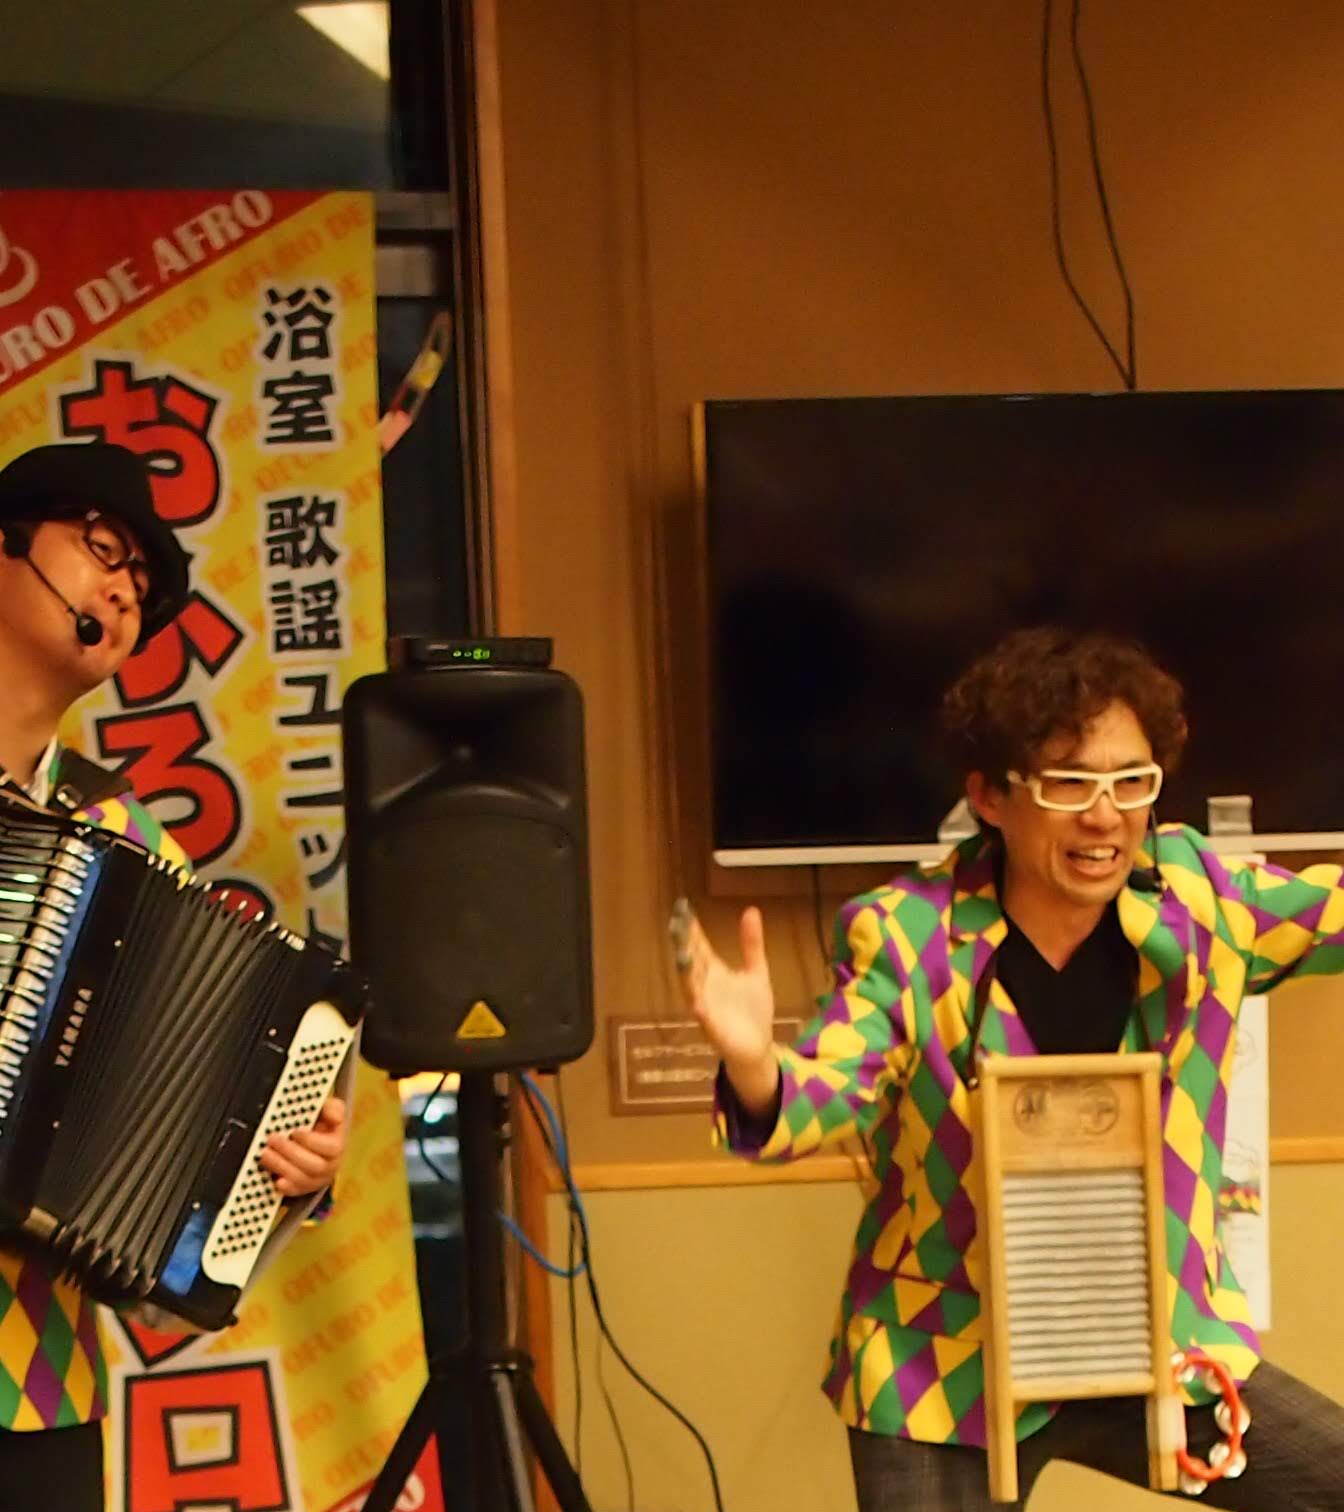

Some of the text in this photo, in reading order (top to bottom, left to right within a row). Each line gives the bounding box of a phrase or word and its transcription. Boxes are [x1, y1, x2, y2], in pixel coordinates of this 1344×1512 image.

[74, 258, 153, 325] DE
[152, 189, 274, 281] AFRO
[263, 287, 335, 444] 浴室
[54, 988, 94, 1067] YAMAHA
